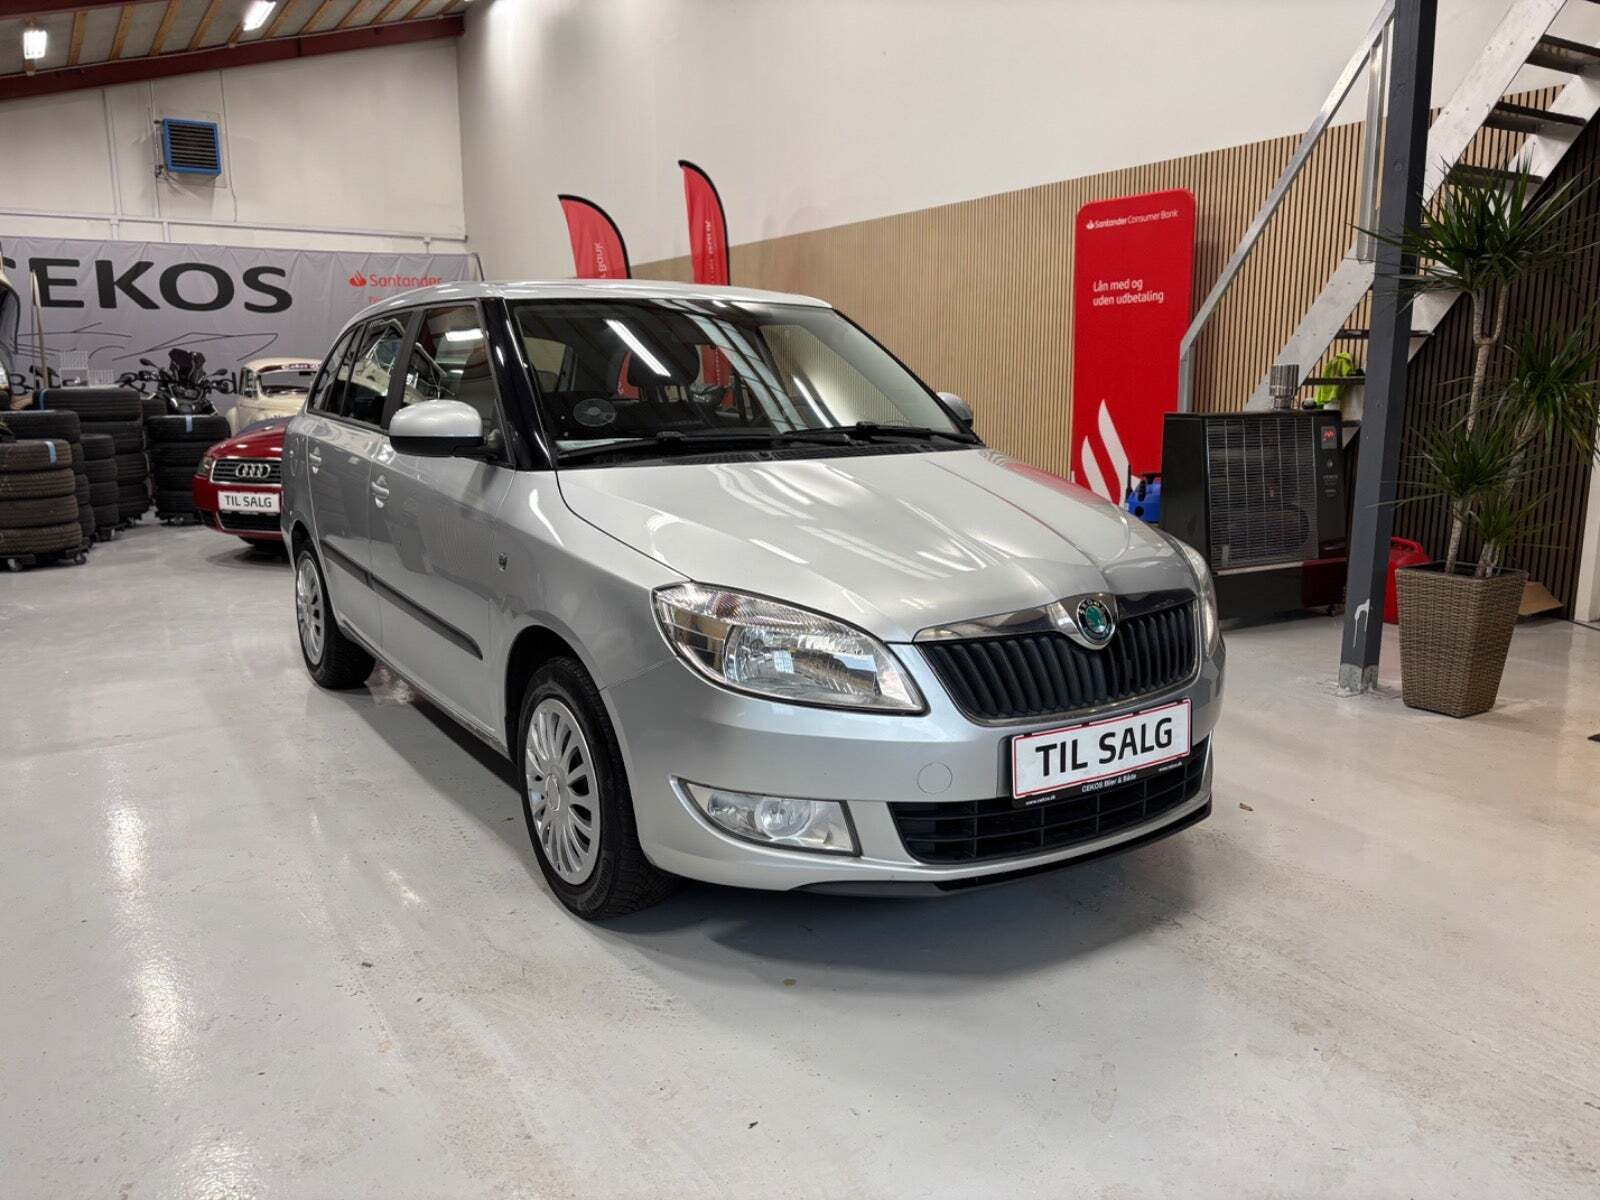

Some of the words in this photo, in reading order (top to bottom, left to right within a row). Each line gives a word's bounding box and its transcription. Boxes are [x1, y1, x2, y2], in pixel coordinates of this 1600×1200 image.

[1094, 217, 1127, 229] Santander
[1127, 212, 1160, 225] Consumer
[1160, 208, 1178, 220] Bank
[2, 256, 293, 314] EKOS
[369, 273, 442, 288] Santander
[1093, 280, 1108, 292] Lån
[1110, 279, 1130, 290] med
[1131, 279, 1143, 291] og
[1092, 295, 1115, 306] uden
[1116, 291, 1164, 304] udbetaling
[224, 495, 241, 506] TIL
[243, 496, 272, 508] SALG
[1035, 738, 1089, 776] TIL
[1098, 717, 1172, 765] SALG
